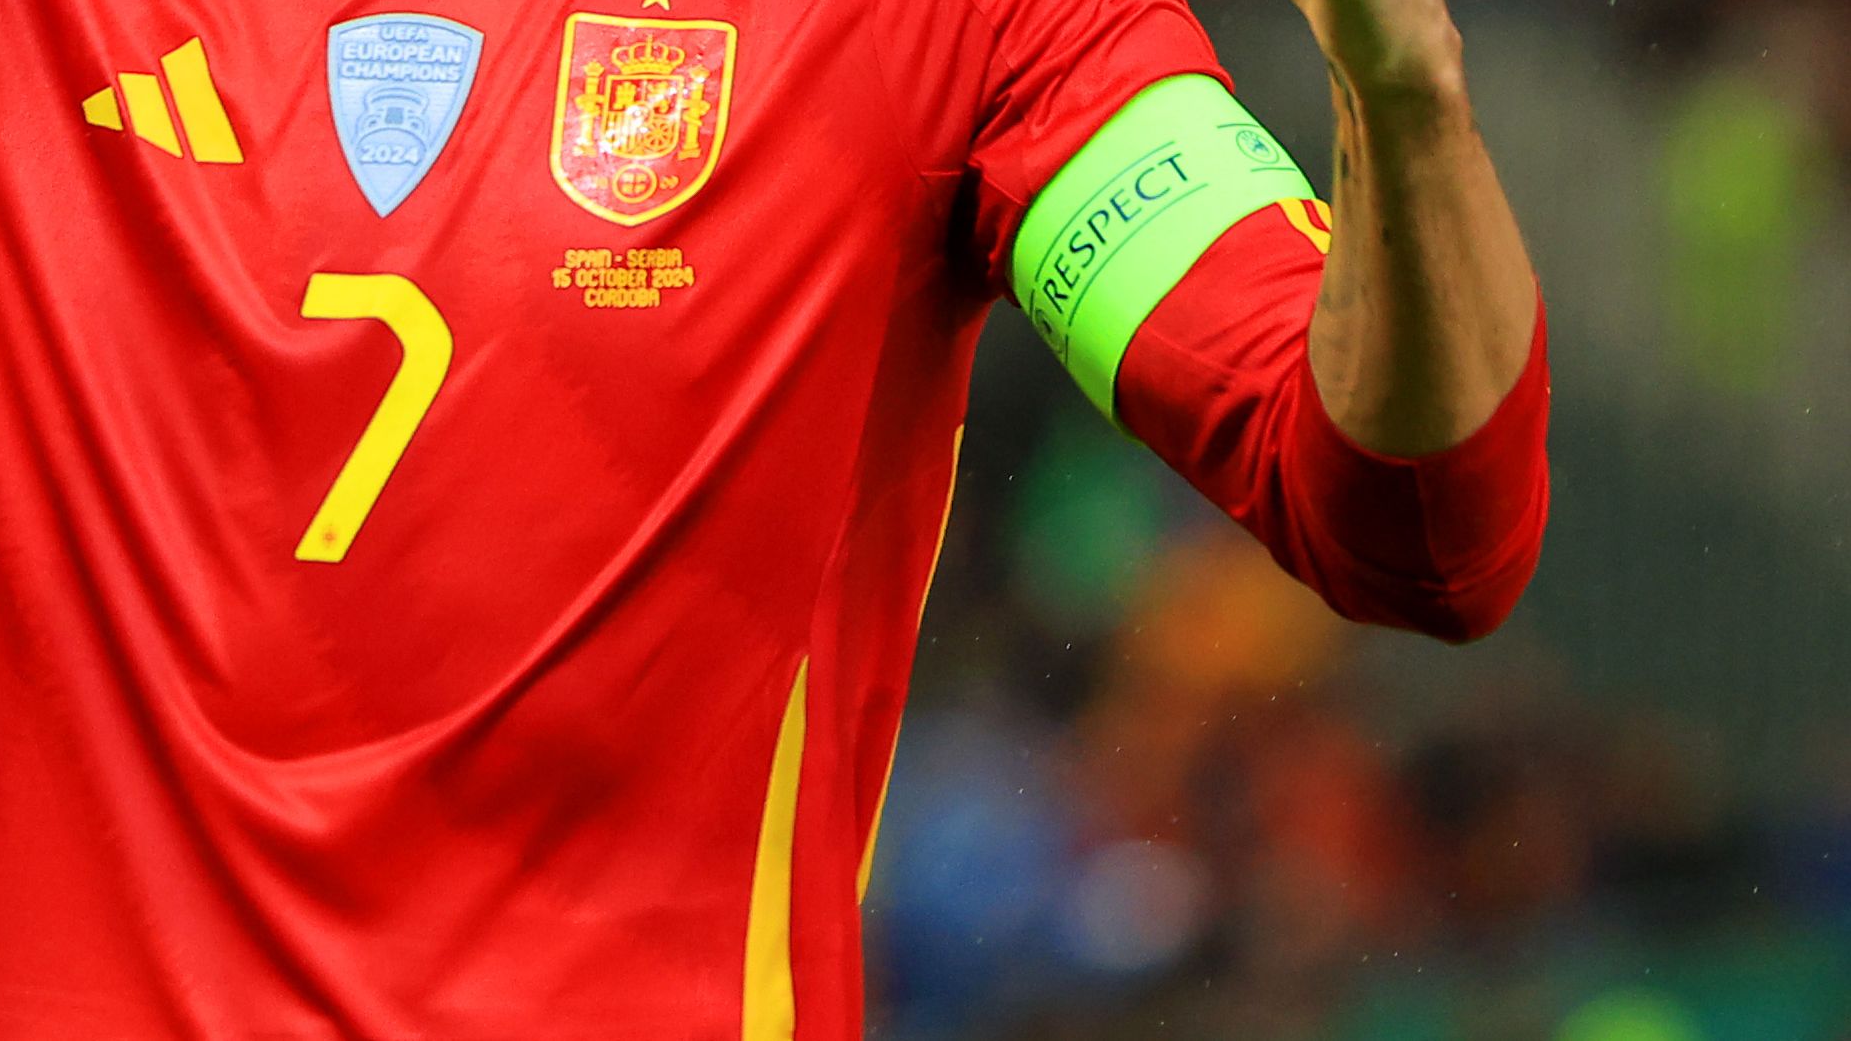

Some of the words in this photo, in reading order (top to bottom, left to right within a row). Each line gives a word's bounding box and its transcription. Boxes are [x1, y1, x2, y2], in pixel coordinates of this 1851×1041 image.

[380, 24, 429, 41] UEFA
[342, 42, 462, 64] EUROPEAN
[341, 61, 461, 82] CHAMPIONS
[359, 145, 421, 165] 2024
[1042, 152, 1189, 314] RESPECT
[564, 248, 612, 268] SPAIN
[626, 248, 683, 268] SERBIA
[552, 267, 572, 288] 15
[575, 267, 647, 288] OCTOBER
[651, 265, 694, 288] 2024
[584, 287, 660, 307] CORDOBA
[295, 272, 454, 563] 7
